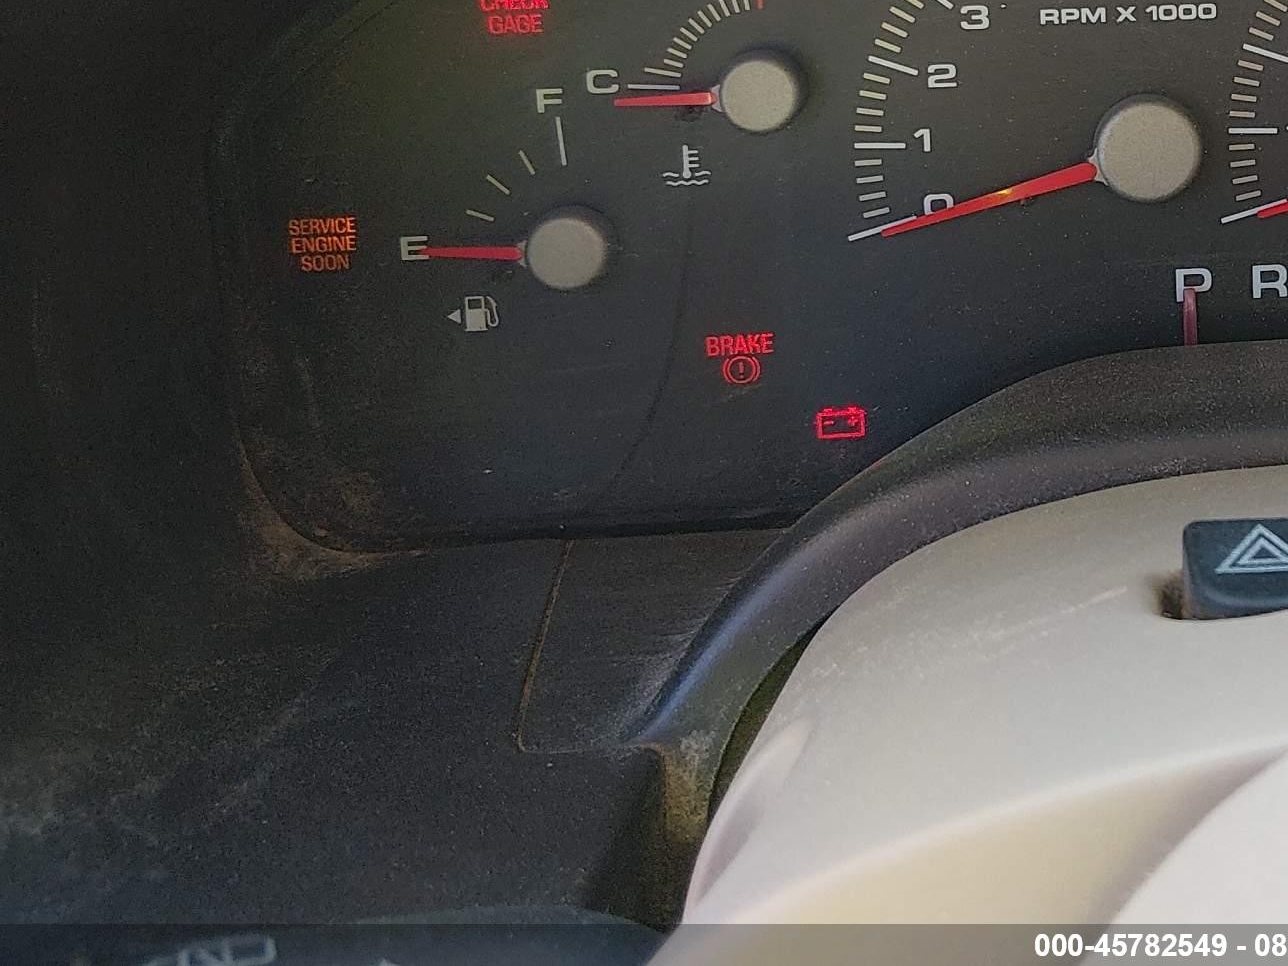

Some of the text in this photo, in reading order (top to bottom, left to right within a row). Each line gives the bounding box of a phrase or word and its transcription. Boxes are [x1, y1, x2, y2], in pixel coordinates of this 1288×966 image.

[488, 14, 544, 34] GAGE
[960, 5, 990, 30] 3
[1039, 3, 1217, 25] RPM X 1000
[586, 69, 619, 94] C
[927, 64, 957, 88] 2
[536, 89, 563, 113] F
[913, 128, 931, 151] 1
[289, 217, 356, 234] SERVICE
[291, 235, 357, 253] ENGINE
[401, 235, 430, 260] E
[301, 254, 350, 271] SOON
[1175, 268, 1212, 302] P
[706, 332, 774, 356] BRAKE
